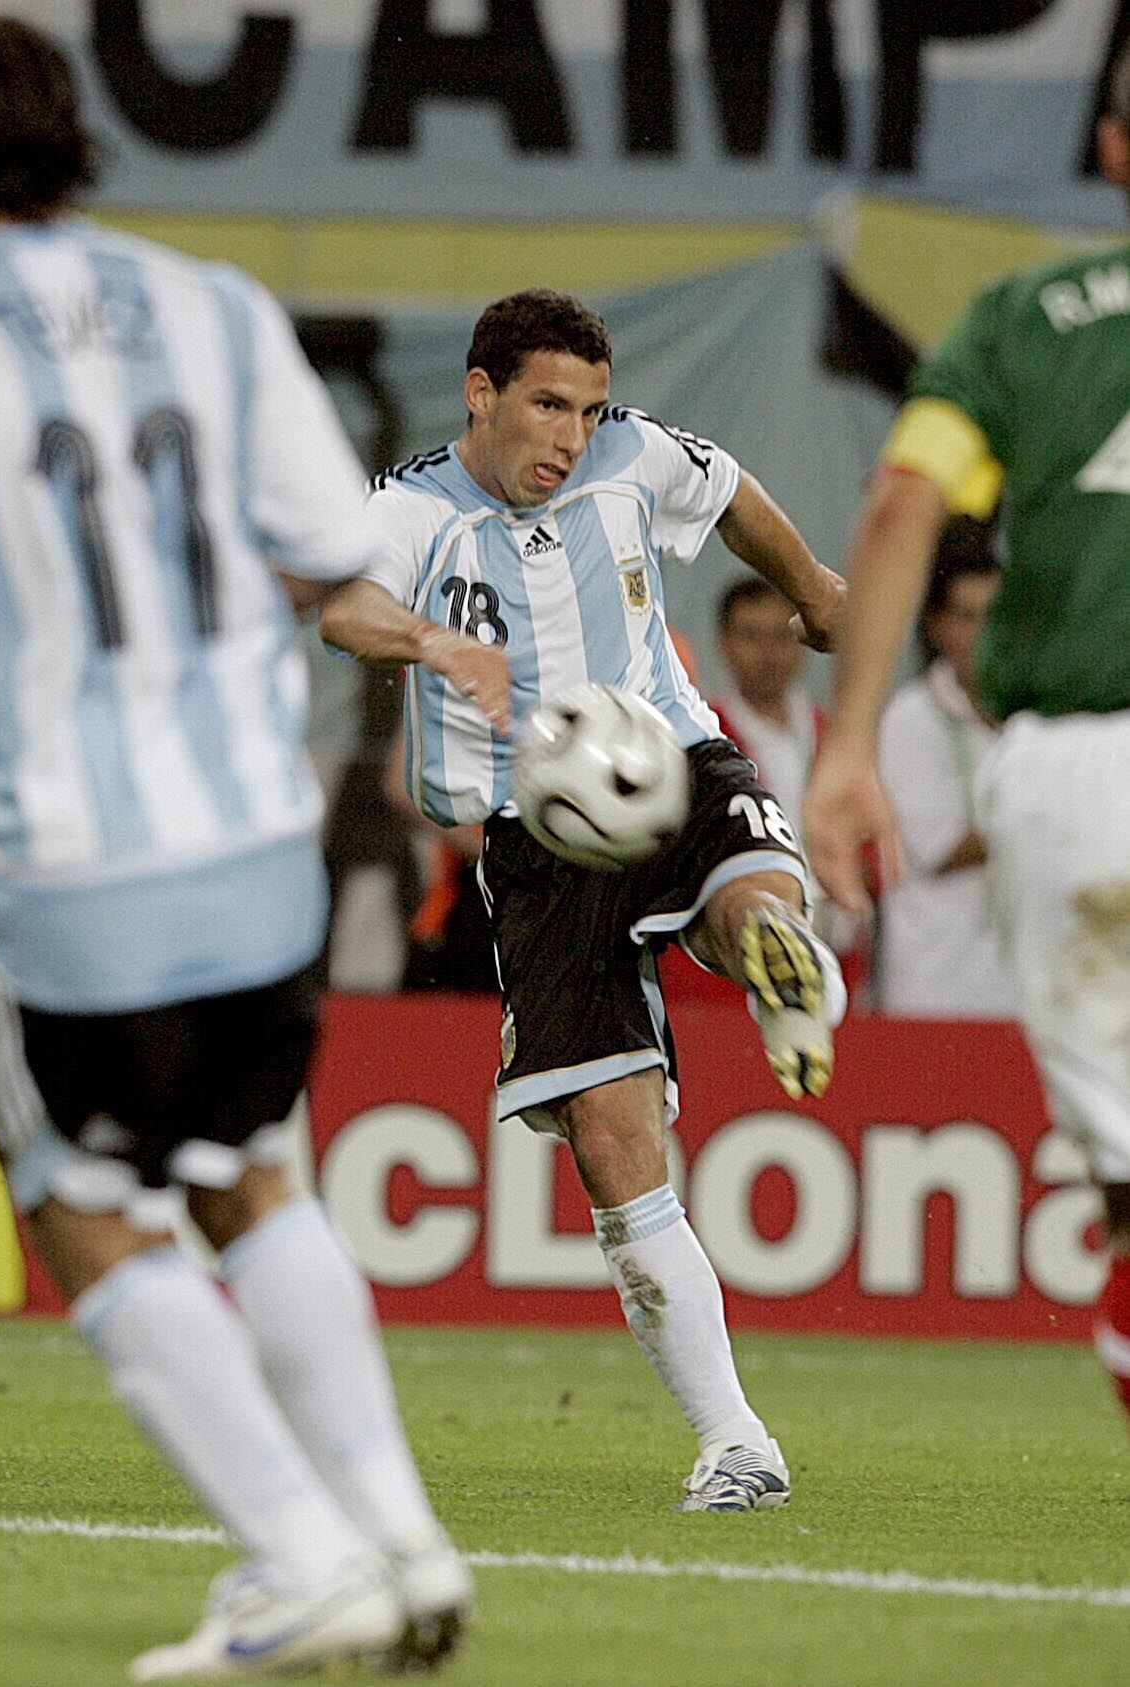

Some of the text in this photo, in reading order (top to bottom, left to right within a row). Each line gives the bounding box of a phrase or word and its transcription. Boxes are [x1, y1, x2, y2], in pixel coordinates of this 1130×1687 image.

[33, 403, 220, 652] 11
[441, 576, 509, 649] 18
[727, 794, 800, 852] 18
